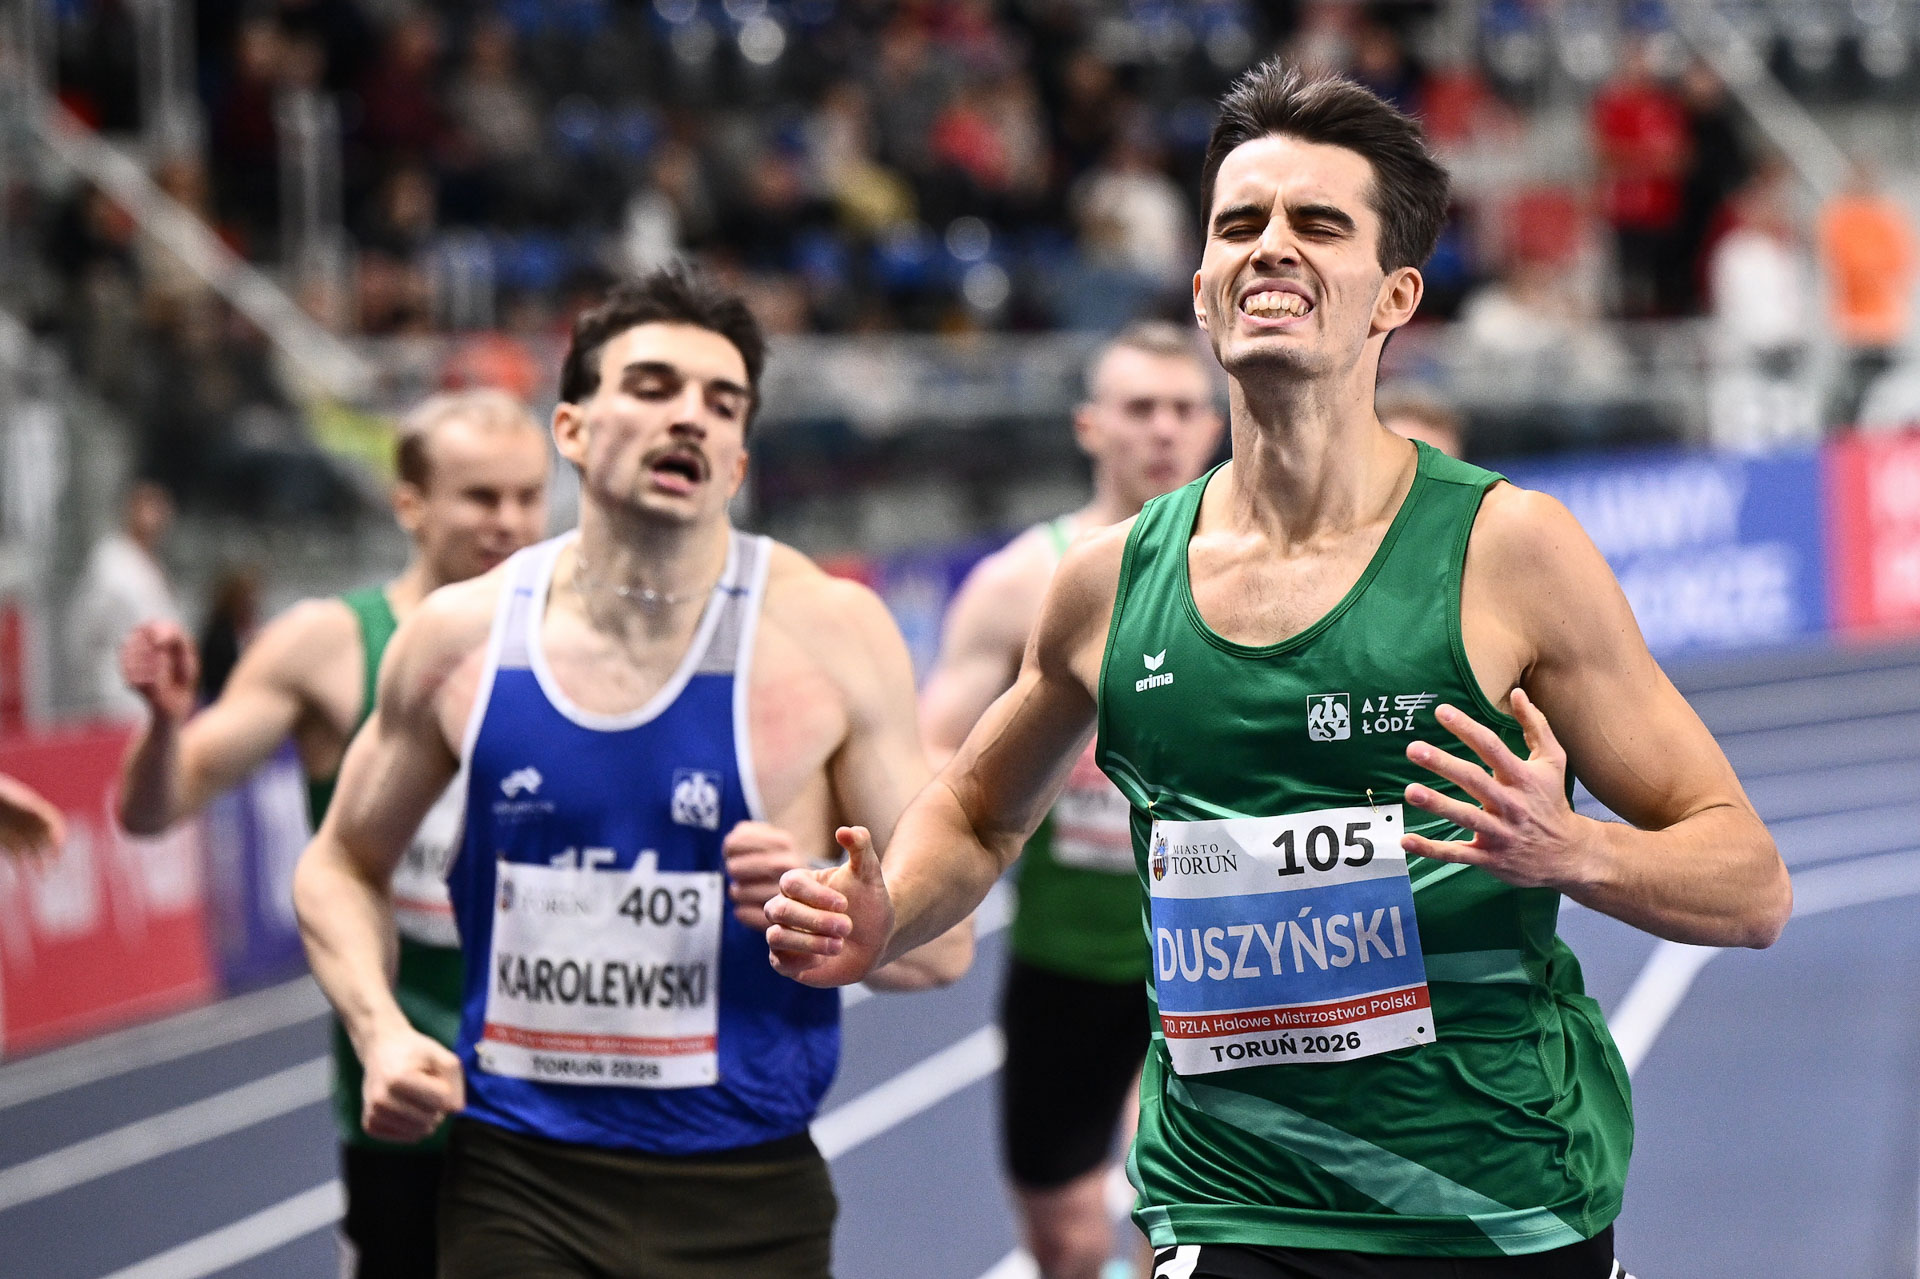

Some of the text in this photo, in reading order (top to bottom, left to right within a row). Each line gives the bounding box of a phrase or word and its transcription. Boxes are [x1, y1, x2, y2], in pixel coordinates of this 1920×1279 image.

[1136, 672, 1174, 692] erima
[1171, 849, 1238, 875] TORUŃ
[1173, 843, 1219, 855] MIASTO
[1272, 821, 1375, 877] 105
[618, 885, 701, 926] 403
[1157, 906, 1407, 983] DUSZYŃSKI
[497, 953, 708, 1009] KAROLEWSKI
[1164, 992, 1417, 1034] 70. PZLA Halowe Mistrzostwa Polski
[1210, 1031, 1361, 1062] TORUŃ 2026
